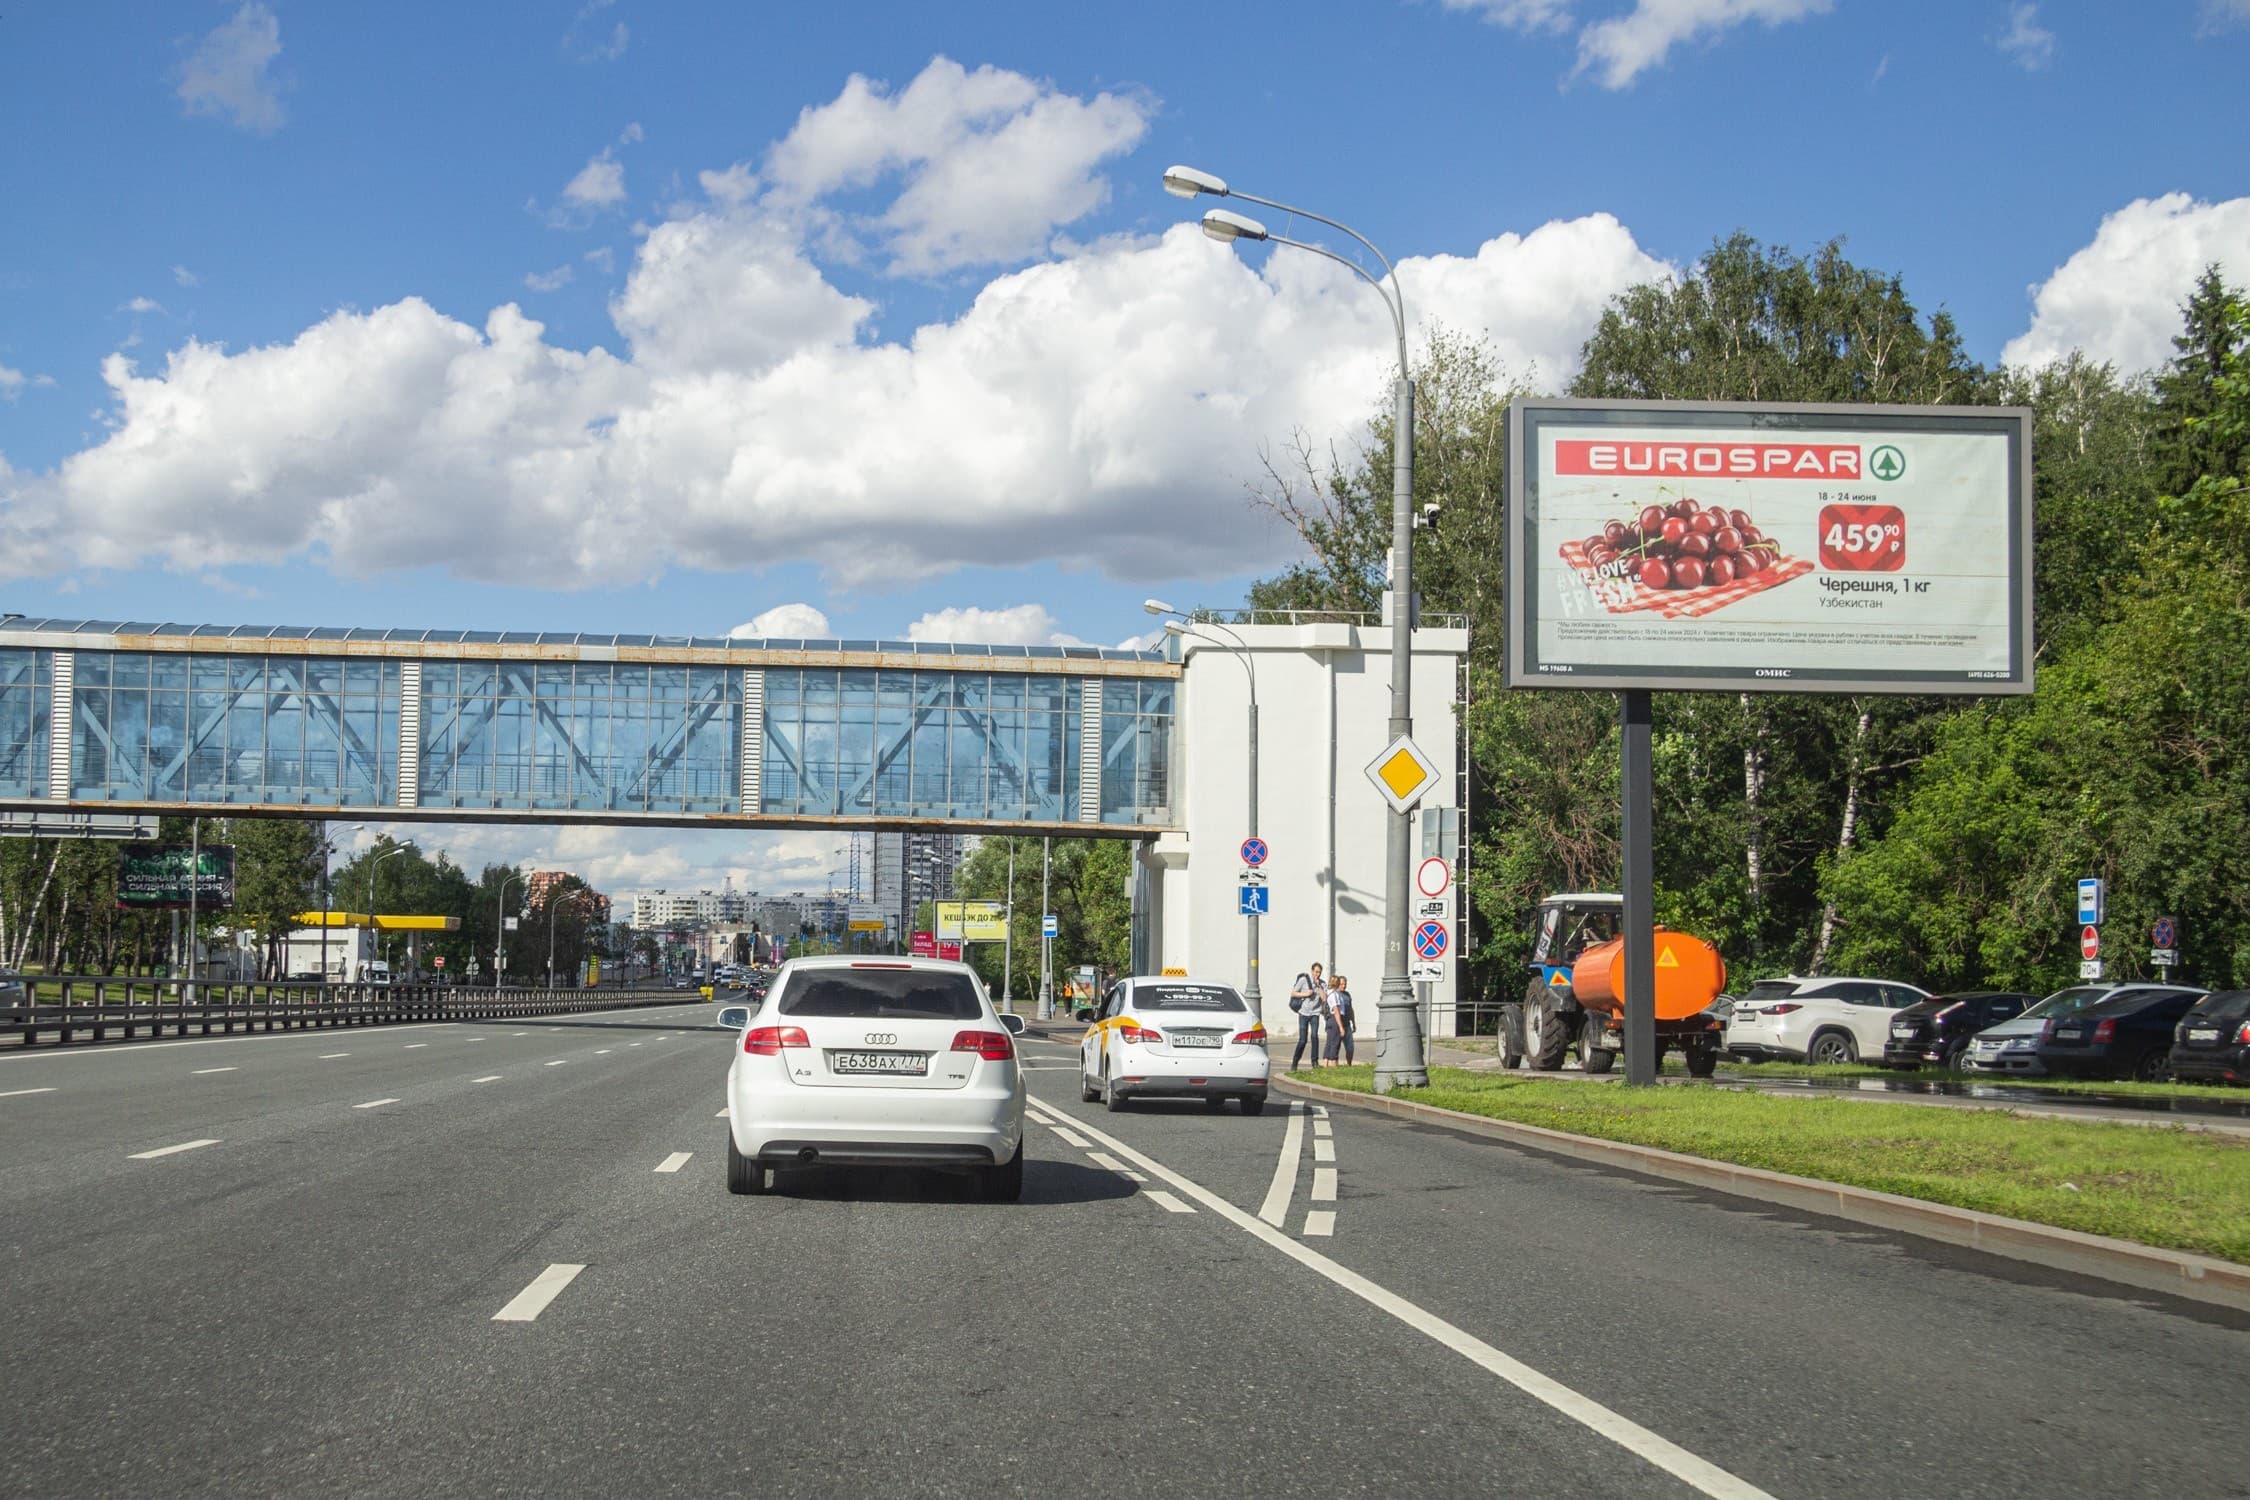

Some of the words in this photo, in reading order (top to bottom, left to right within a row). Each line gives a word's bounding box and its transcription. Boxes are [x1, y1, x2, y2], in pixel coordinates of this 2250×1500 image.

[1588, 446, 1858, 474] EUROSPAR
[1818, 492, 1828, 500] 18
[1838, 492, 1849, 500] 24
[1824, 523, 1884, 552] 459
[1884, 525, 1900, 536] 90
[1593, 559, 1629, 581] LOVE
[1819, 577, 1898, 595] Черешня,
[1903, 578, 1909, 592] 1
[1914, 582, 1931, 592] кг
[1819, 597, 1883, 608] Узбекистан
[1755, 668, 1791, 678] ОМИС
[126, 874, 177, 882] СИЛЬНАЯ
[128, 883, 178, 891] СИЛЬНАЯ
[944, 913, 977, 922] КЕШЭК
[977, 914, 988, 922] ДО
[900, 1055, 922, 1066] 777
